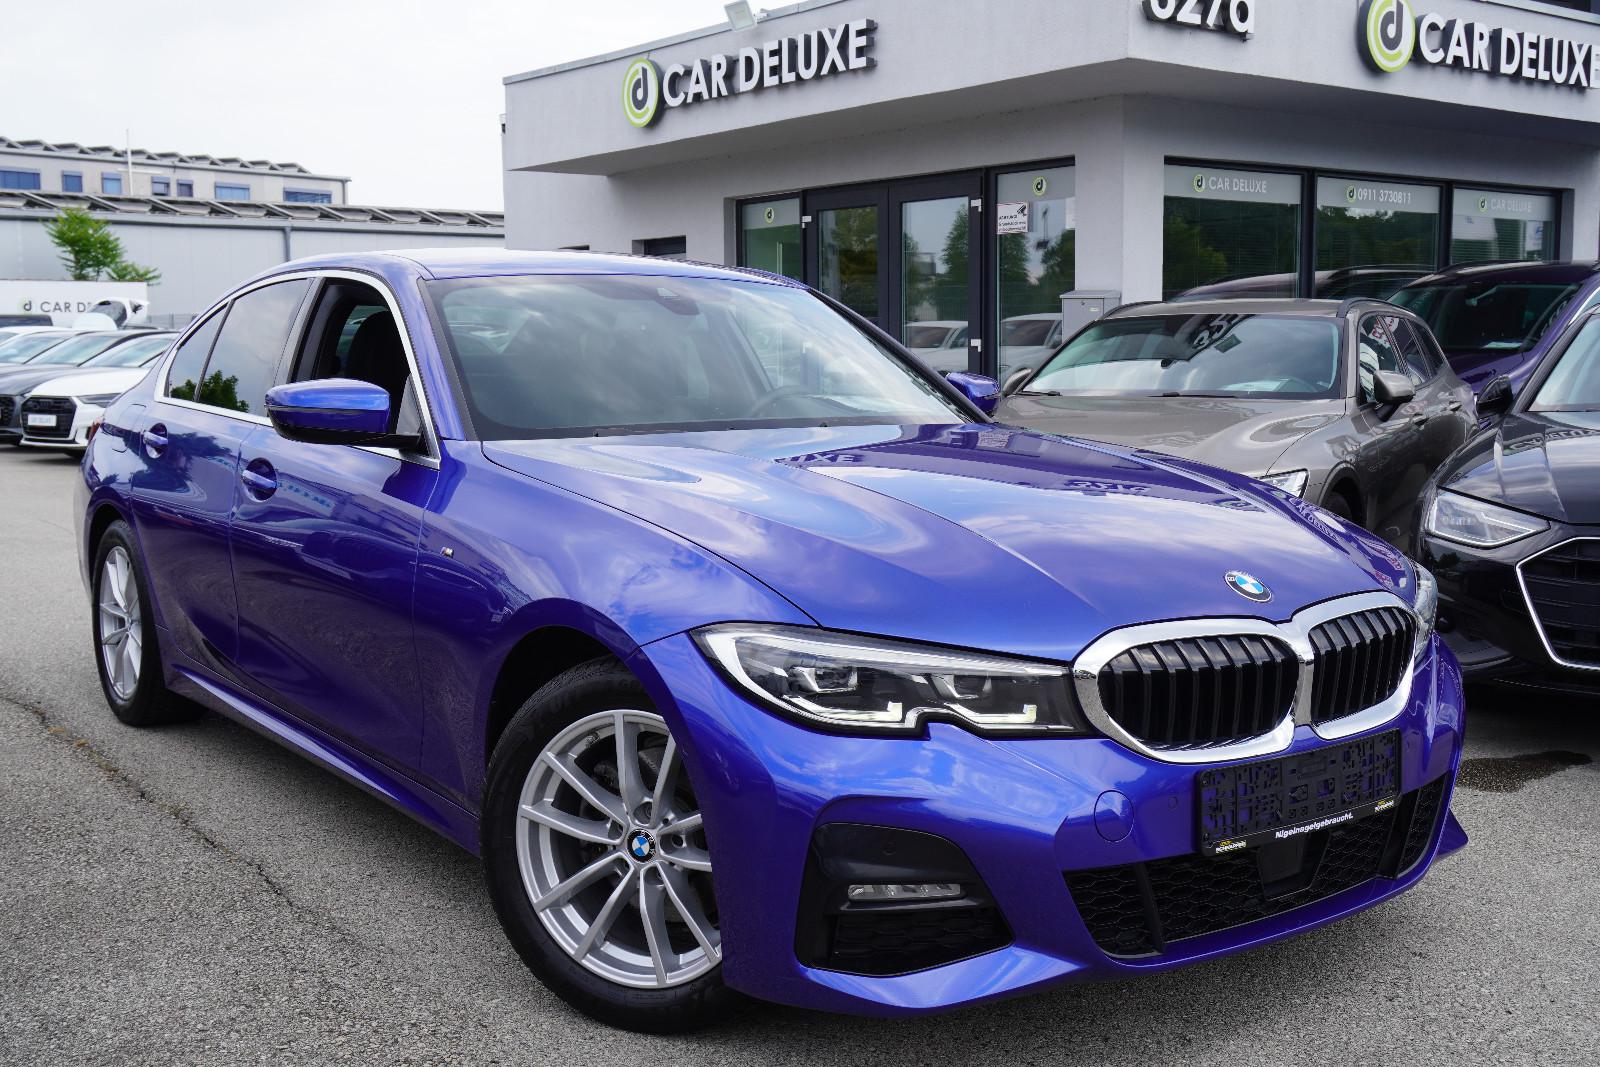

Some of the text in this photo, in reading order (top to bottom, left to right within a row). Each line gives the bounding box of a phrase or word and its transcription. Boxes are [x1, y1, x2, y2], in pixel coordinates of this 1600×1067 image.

[1419, 12, 1490, 72] CAR
[1501, 27, 1600, 88] DELUXE
[662, 53, 728, 108] CAR
[738, 18, 869, 93] DELUXE
[1208, 176, 1230, 191] CAR
[1232, 178, 1267, 193] DELUXE
[1357, 188, 1376, 201] 0911
[40, 301, 71, 313] CAR
